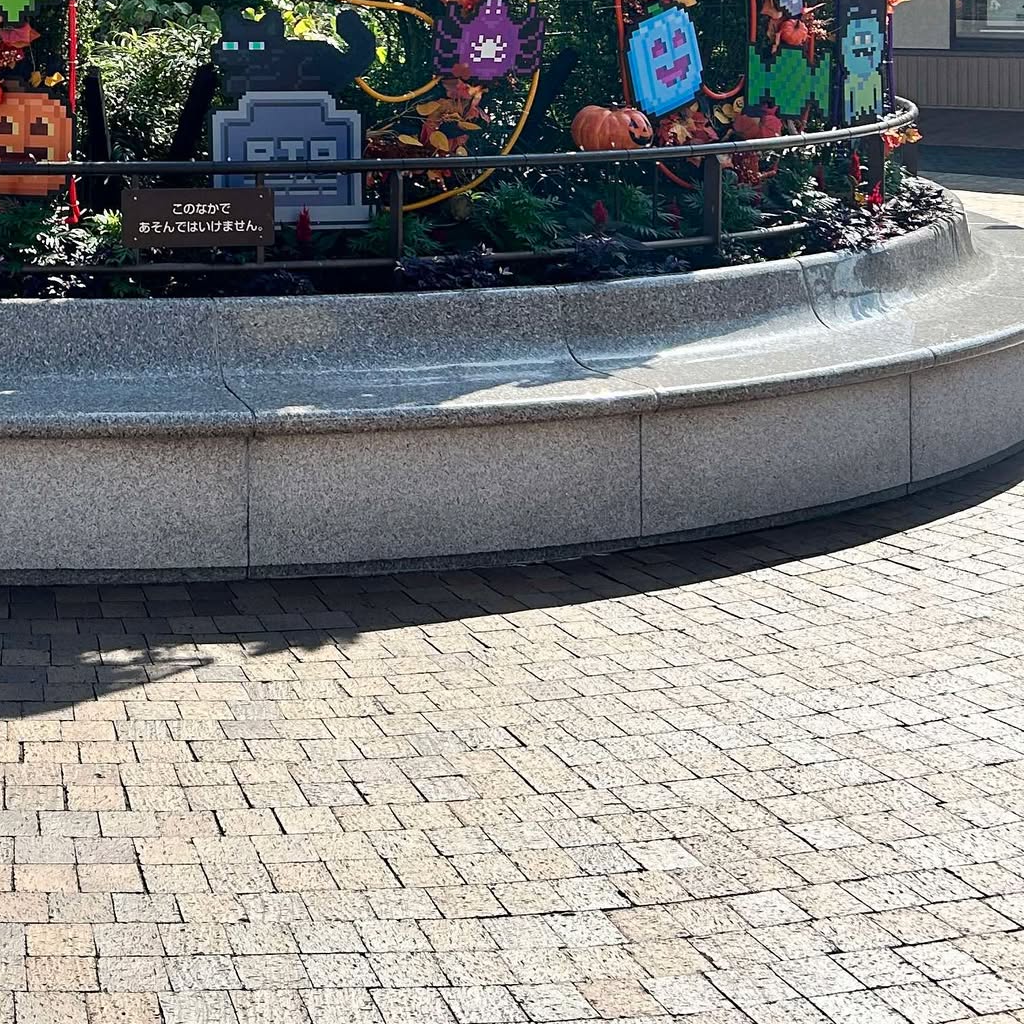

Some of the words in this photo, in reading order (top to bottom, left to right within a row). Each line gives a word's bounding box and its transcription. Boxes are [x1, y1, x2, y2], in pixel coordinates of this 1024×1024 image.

[172, 202, 231, 215] このなかで
[138, 220, 264, 233] あそんではいけません。
